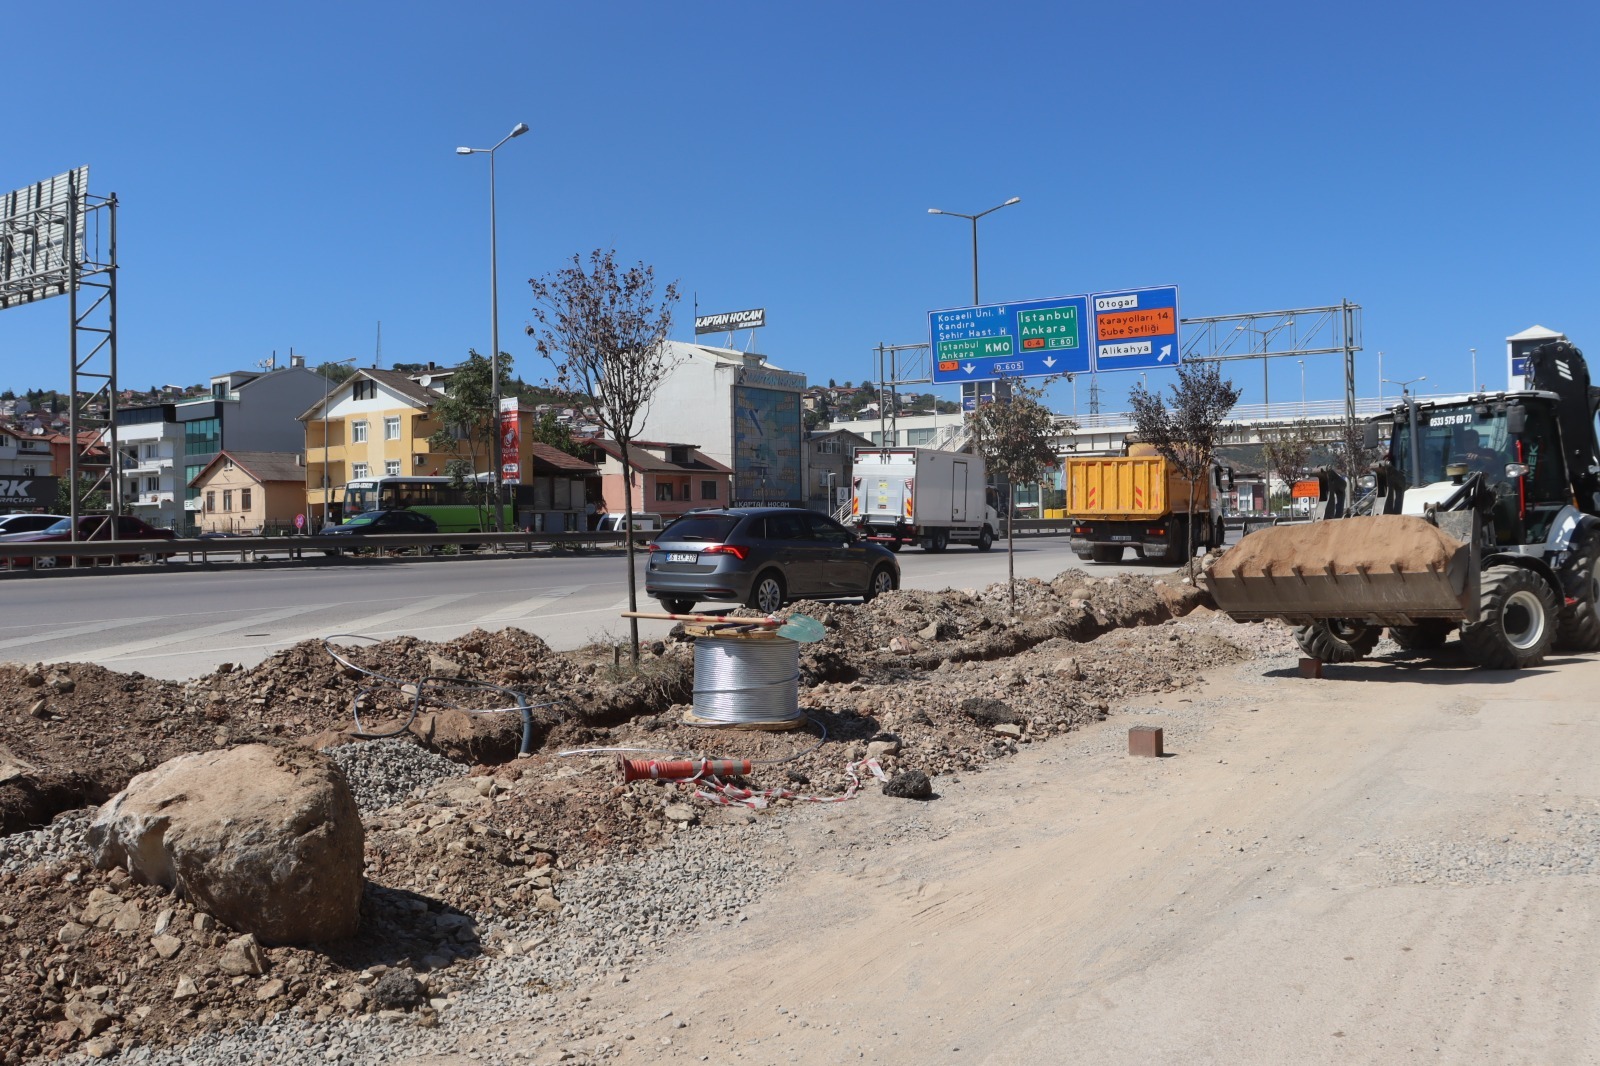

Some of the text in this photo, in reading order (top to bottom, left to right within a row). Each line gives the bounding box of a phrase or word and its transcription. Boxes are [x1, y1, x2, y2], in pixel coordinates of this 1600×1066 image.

[1099, 299, 1134, 308] Otogar
[695, 314, 730, 328] KAPTAN
[730, 309, 763, 323] HOCAM
[938, 312, 972, 322] Kocaeli
[976, 308, 994, 318] Üni.
[1020, 309, 1074, 323] İstanbul
[1099, 314, 1153, 325] Karayolları
[938, 322, 975, 331] Kandıra
[1022, 325, 1066, 335] Ankara
[1100, 324, 1159, 337] Şube Şefliği
[939, 332, 964, 341] Şehir
[968, 328, 996, 337] Hast.
[939, 340, 979, 352] İstanbul
[985, 341, 1010, 353] KMO
[1102, 345, 1149, 355] Alikahya
[941, 351, 975, 360] Ankara
[996, 362, 1022, 371] D.605
[1430, 417, 1444, 427] 0533
[1444, 415, 1456, 426] 575
[1464, 413, 1473, 424] 77
